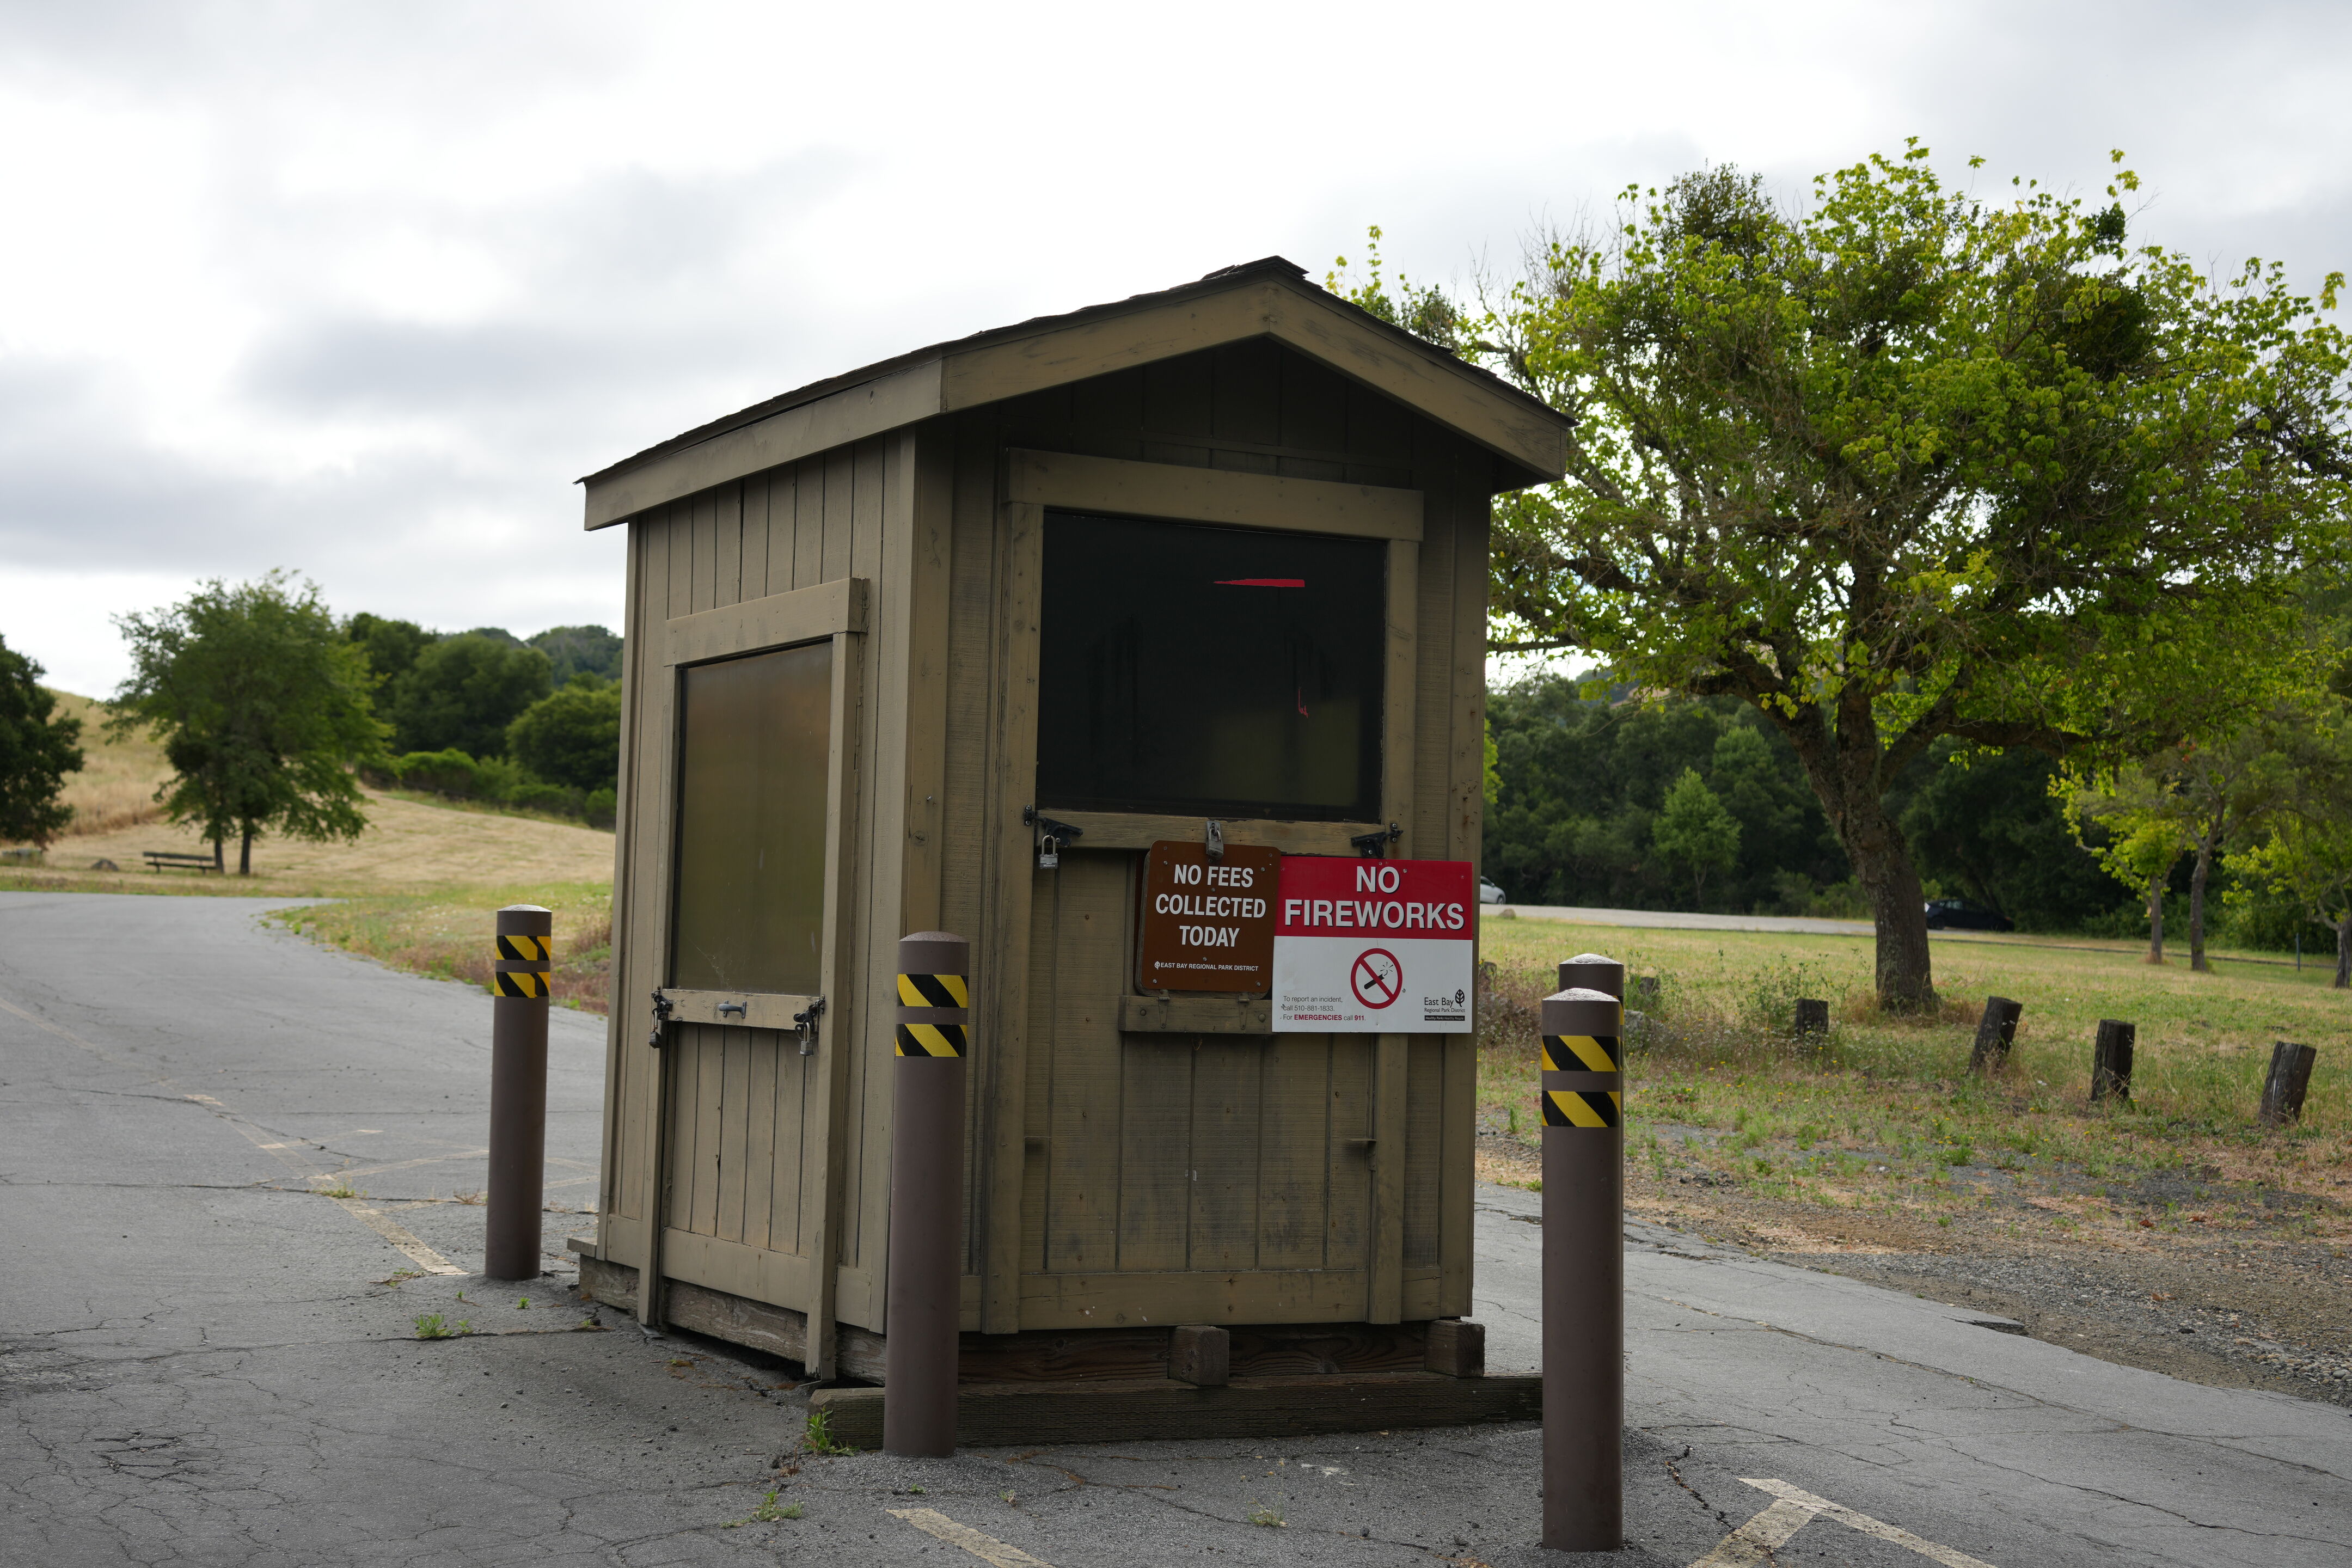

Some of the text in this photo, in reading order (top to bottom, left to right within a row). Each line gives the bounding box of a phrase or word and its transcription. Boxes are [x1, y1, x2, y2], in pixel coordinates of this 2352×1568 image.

[1174, 864, 1253, 887] NO FEES
[1356, 866, 1400, 893] NO
[1155, 893, 1266, 918] COLLECTED
[1285, 899, 1465, 929] FIREWORKS
[1179, 926, 1240, 947] TODAY
[1424, 997, 1454, 1008] East Bay
